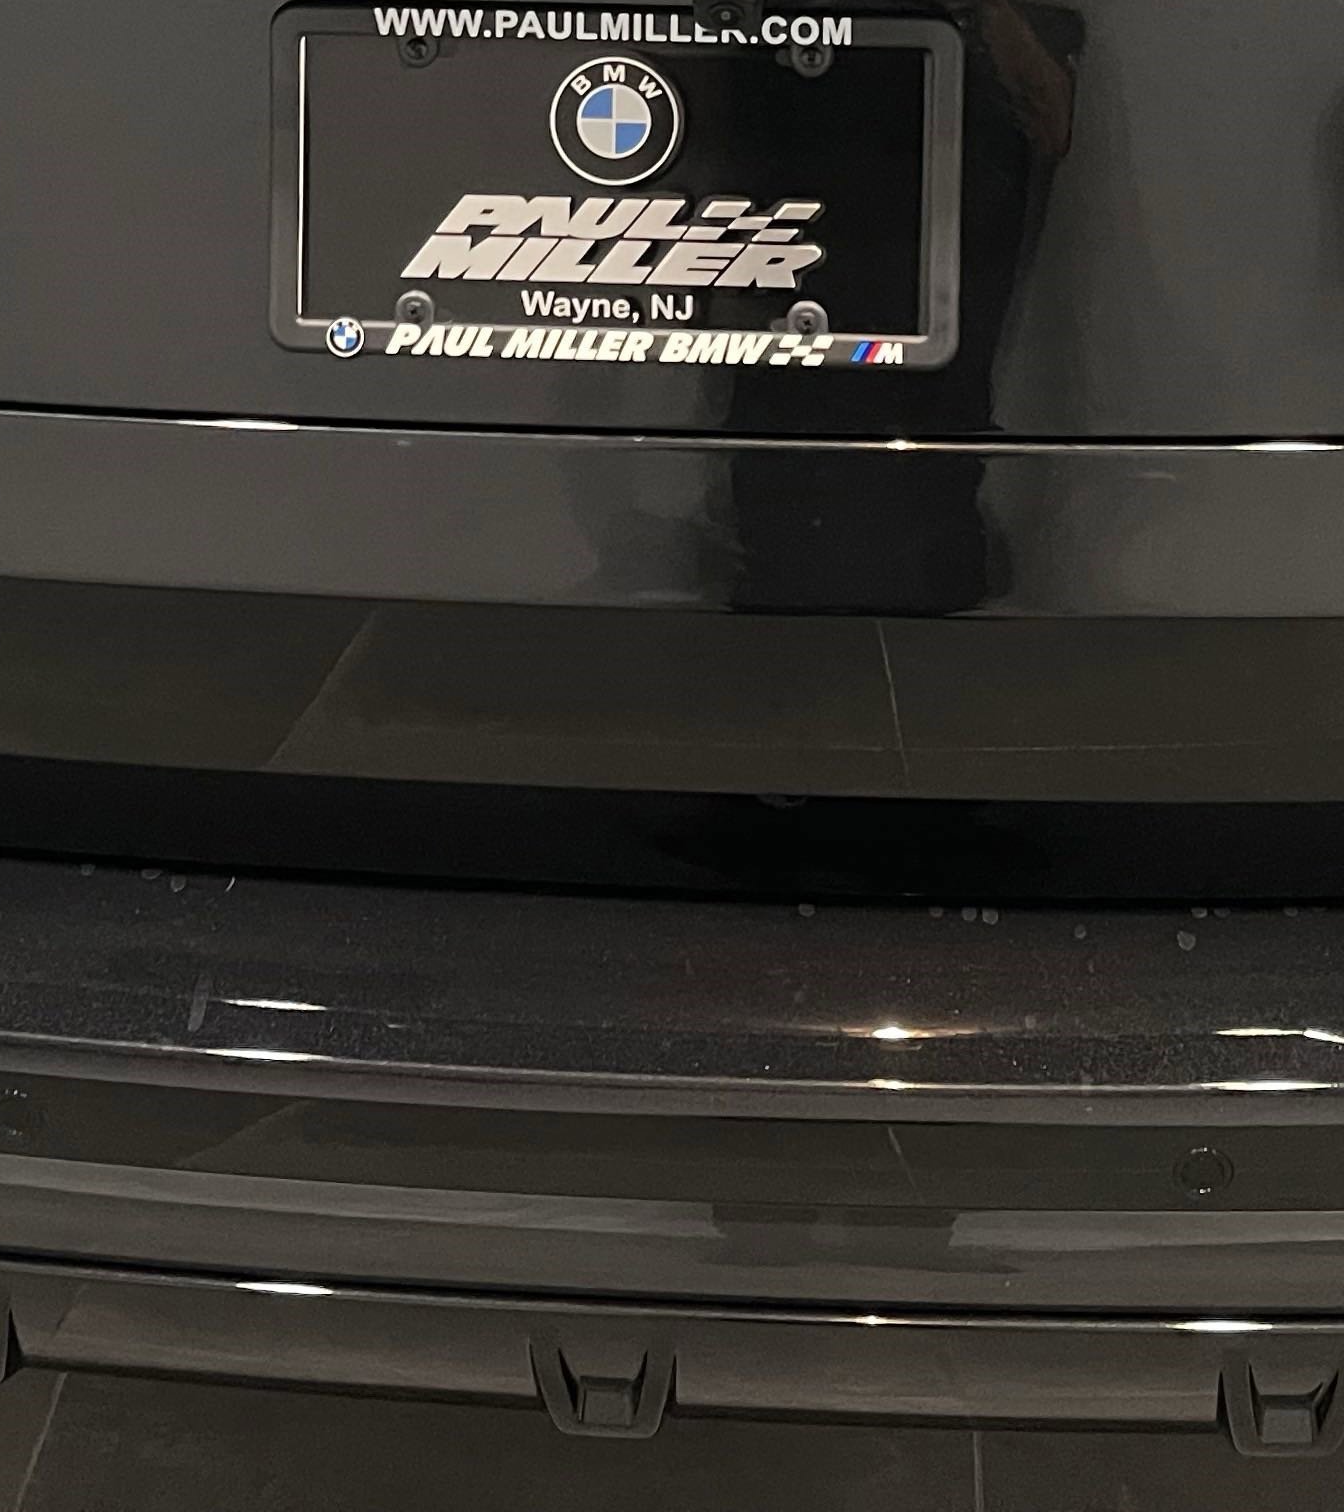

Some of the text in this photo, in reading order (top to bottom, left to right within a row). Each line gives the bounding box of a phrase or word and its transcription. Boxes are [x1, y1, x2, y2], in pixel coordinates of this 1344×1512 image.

[570, 64, 663, 100] BMW
[435, 193, 688, 240] PAUL
[400, 234, 823, 288] MILLER
[520, 290, 695, 324] Wayne, NJ
[384, 323, 494, 357] PAUL
[500, 328, 655, 362] MILLER
[658, 332, 774, 367] BMW
